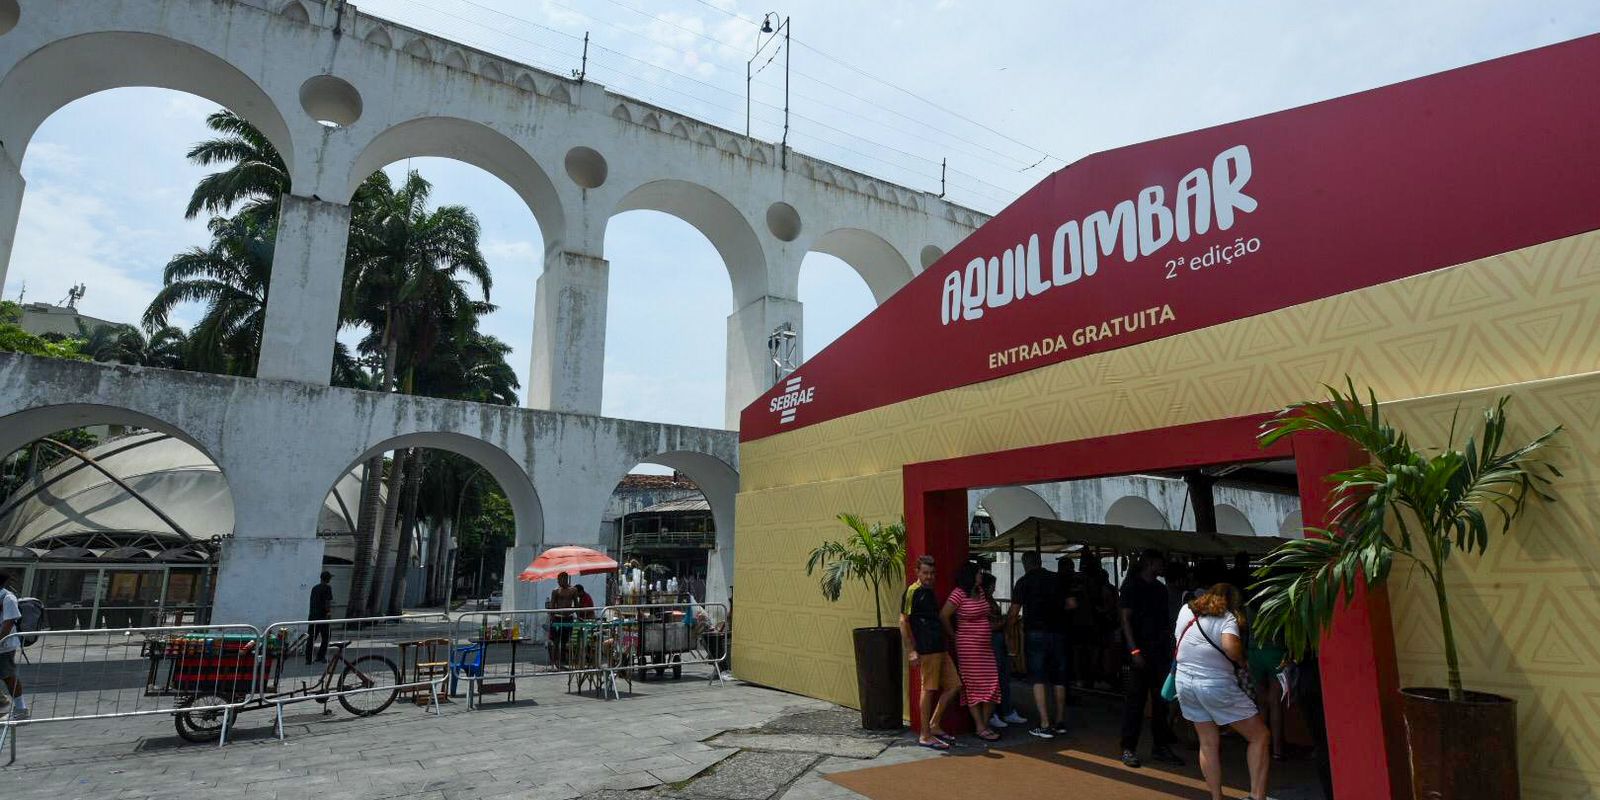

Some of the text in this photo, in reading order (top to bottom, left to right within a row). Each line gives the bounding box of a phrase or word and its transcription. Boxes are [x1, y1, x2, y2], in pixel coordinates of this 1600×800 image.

[940, 144, 1258, 325] AQUILOMBAR
[1165, 236, 1261, 279] 2ª edição
[988, 304, 1176, 369] ENTRADA GRATUITA
[769, 386, 815, 412] SEBRAE
